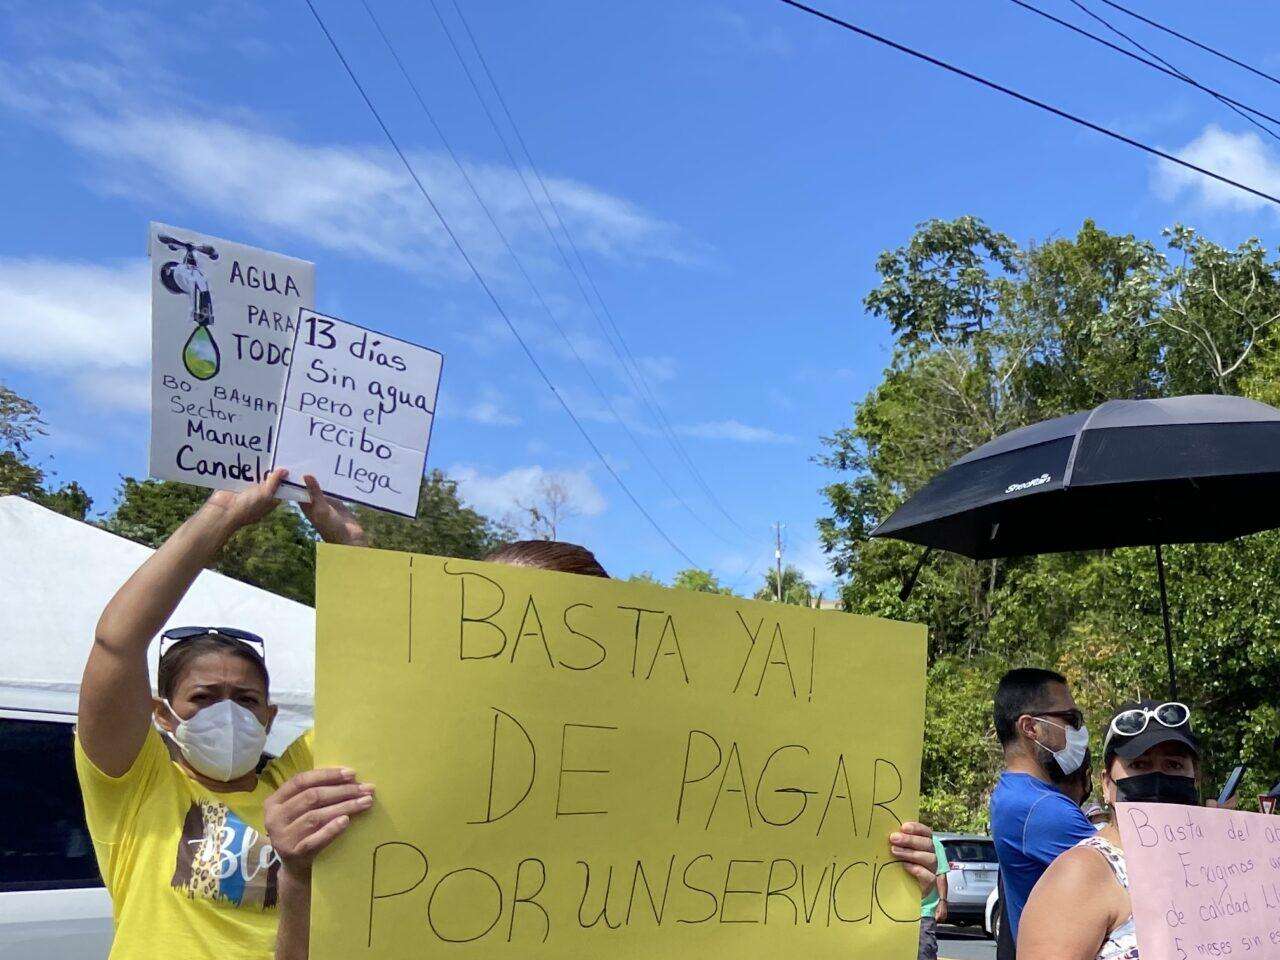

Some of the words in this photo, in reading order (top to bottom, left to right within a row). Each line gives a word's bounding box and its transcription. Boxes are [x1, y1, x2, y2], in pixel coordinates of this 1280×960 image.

[229, 261, 301, 297] AGUA
[248, 305, 294, 333] PARA
[305, 317, 336, 349] 13
[171, 395, 237, 423] Sector
[363, 402, 383, 426] el
[368, 380, 434, 414] agua
[187, 419, 273, 453] Manuel
[308, 416, 393, 460] recibo
[176, 444, 272, 484] Candel
[334, 454, 402, 495] Llega
[467, 706, 618, 825] DE
[677, 730, 904, 838] PAGAR
[1128, 807, 1204, 847] Basta
[1227, 815, 1250, 841] del
[368, 841, 551, 947] POR
[1166, 900, 1186, 928] de
[1199, 892, 1250, 921] calidad
[1196, 939, 1232, 957] meses
